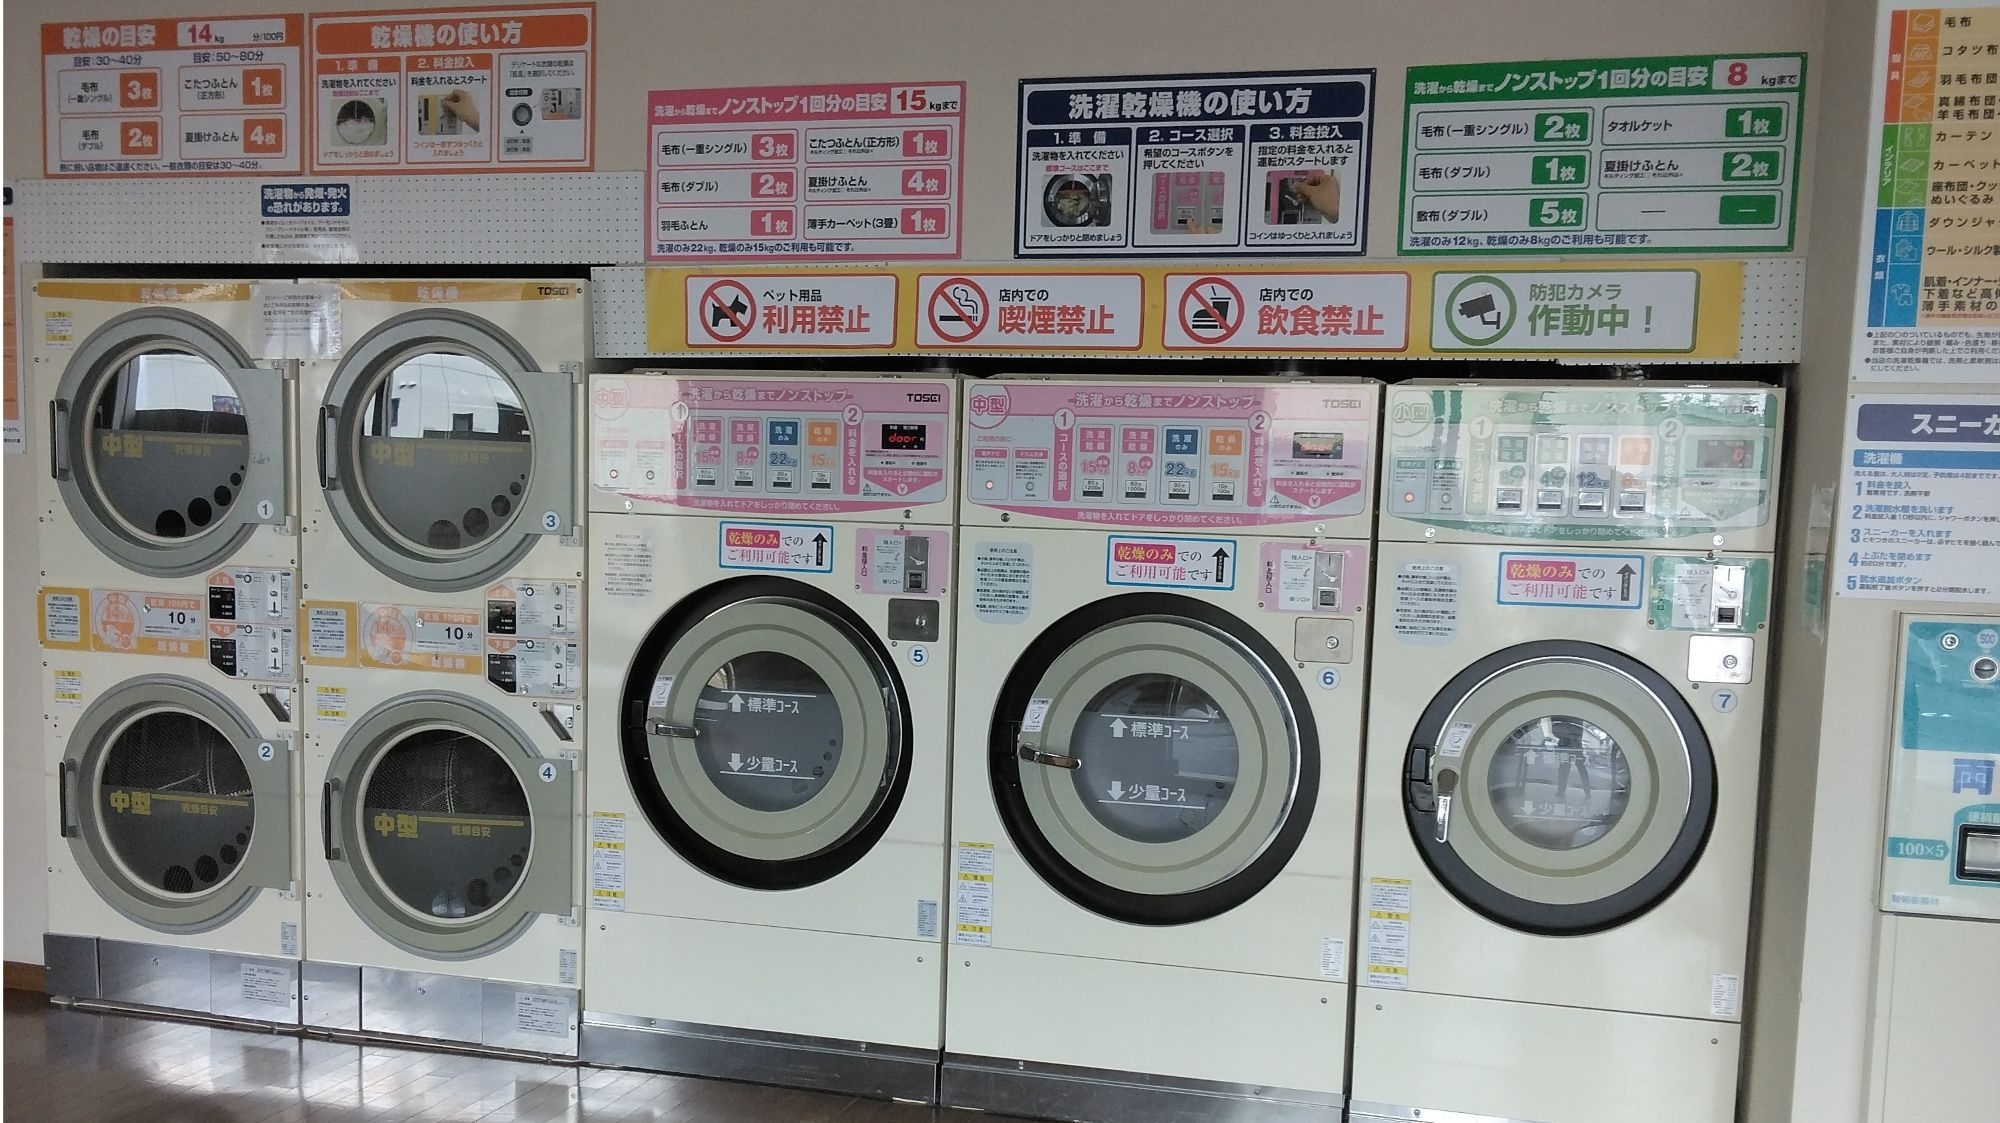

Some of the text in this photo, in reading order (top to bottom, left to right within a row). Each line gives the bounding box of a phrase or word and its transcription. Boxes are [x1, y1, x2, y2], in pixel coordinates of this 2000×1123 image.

[1945, 16, 1971, 27] 毛布
[63, 24, 156, 49] 乾燥の目安
[187, 24, 212, 43] 14
[371, 21, 522, 48] 乾燥機の使い方
[433, 56, 475, 68] 料金投入
[184, 78, 237, 89] こたつふとん
[321, 78, 396, 88] 洗濯物を入れてください
[411, 76, 487, 86] 料金を入れるとスタート
[1414, 66, 1708, 95] 洗濯から乾燥までノンストップ1回分の目安
[1727, 62, 1748, 86] 8
[80, 82, 98, 92] 毛布
[655, 93, 887, 117] 洗濯から乾燥までノンストップ1回分の目安
[899, 90, 926, 111] 15
[1068, 88, 1312, 120] 洗濯乾燥機の使い方
[1544, 116, 1580, 139] 2枚
[1607, 119, 1672, 132] タオルケット
[1738, 111, 1769, 134] 1枚
[82, 130, 99, 140] 毛布
[185, 131, 239, 143] 夏掛けふとん
[1169, 127, 1234, 143] コース選択
[1289, 125, 1343, 140] 料金投入
[1936, 131, 1992, 142] カーテン
[759, 137, 788, 157] 3枚
[912, 133, 938, 155] 1枚
[1258, 144, 1354, 156] 指定の料金を入れると
[1031, 150, 1125, 162] 洗濯物を入れてください
[1143, 146, 1234, 158] 希望のコースボタンを
[1142, 159, 1204, 170] 押してください
[1257, 156, 1349, 168] 運転がスタートします
[1604, 160, 1679, 172] 夏掛けふとん
[1730, 154, 1769, 177] 2枚
[1545, 159, 1576, 182] 1枚
[759, 174, 788, 195] 2枚
[808, 176, 868, 188] 夏掛けふとん
[907, 171, 939, 193] 4枚
[267, 201, 342, 213] の恐れがあります。
[1931, 195, 1994, 205] ぬいぐるみ
[1540, 202, 1578, 224] 5枚
[661, 213, 788, 234] 羽毛ふとん 1枚
[910, 209, 936, 232] 1枚
[763, 289, 822, 301] ペット用品
[999, 288, 1049, 301] 店内での
[1259, 287, 1314, 301] 店内での
[1529, 283, 1622, 300] 防犯カメラ
[762, 305, 871, 334] 利用禁止
[998, 305, 1115, 335] 喫煙禁止
[1257, 304, 1385, 337] 飲食禁止
[907, 394, 940, 402] TOSEI
[971, 395, 1006, 415] 中型
[1322, 400, 1361, 408] TOSEI
[848, 408, 857, 421] 2
[1061, 412, 1067, 426] 1
[1255, 415, 1265, 429] 2
[1665, 421, 1677, 438] 2
[1855, 481, 1862, 496] 1
[262, 503, 268, 515] 1
[1852, 504, 1862, 519] 2
[546, 515, 555, 528] 3
[1850, 528, 1861, 543] 3
[728, 549, 813, 565] ご利用可能です
[1848, 552, 1859, 567] 4
[1116, 565, 1212, 582] ご利用可能です
[1847, 576, 1857, 590] 5
[1509, 584, 1617, 600] ご利用可能です
[169, 612, 186, 625] 10
[445, 626, 463, 640] 10
[913, 650, 923, 661] 5
[1323, 671, 1334, 685] 6
[748, 697, 799, 713] 標準コース
[1719, 694, 1730, 708] 7
[1131, 722, 1189, 739] 標準コース
[262, 745, 270, 757] 2
[747, 756, 798, 773] 少量コース
[543, 766, 552, 778] 4
[1129, 784, 1186, 801] 少量コース
